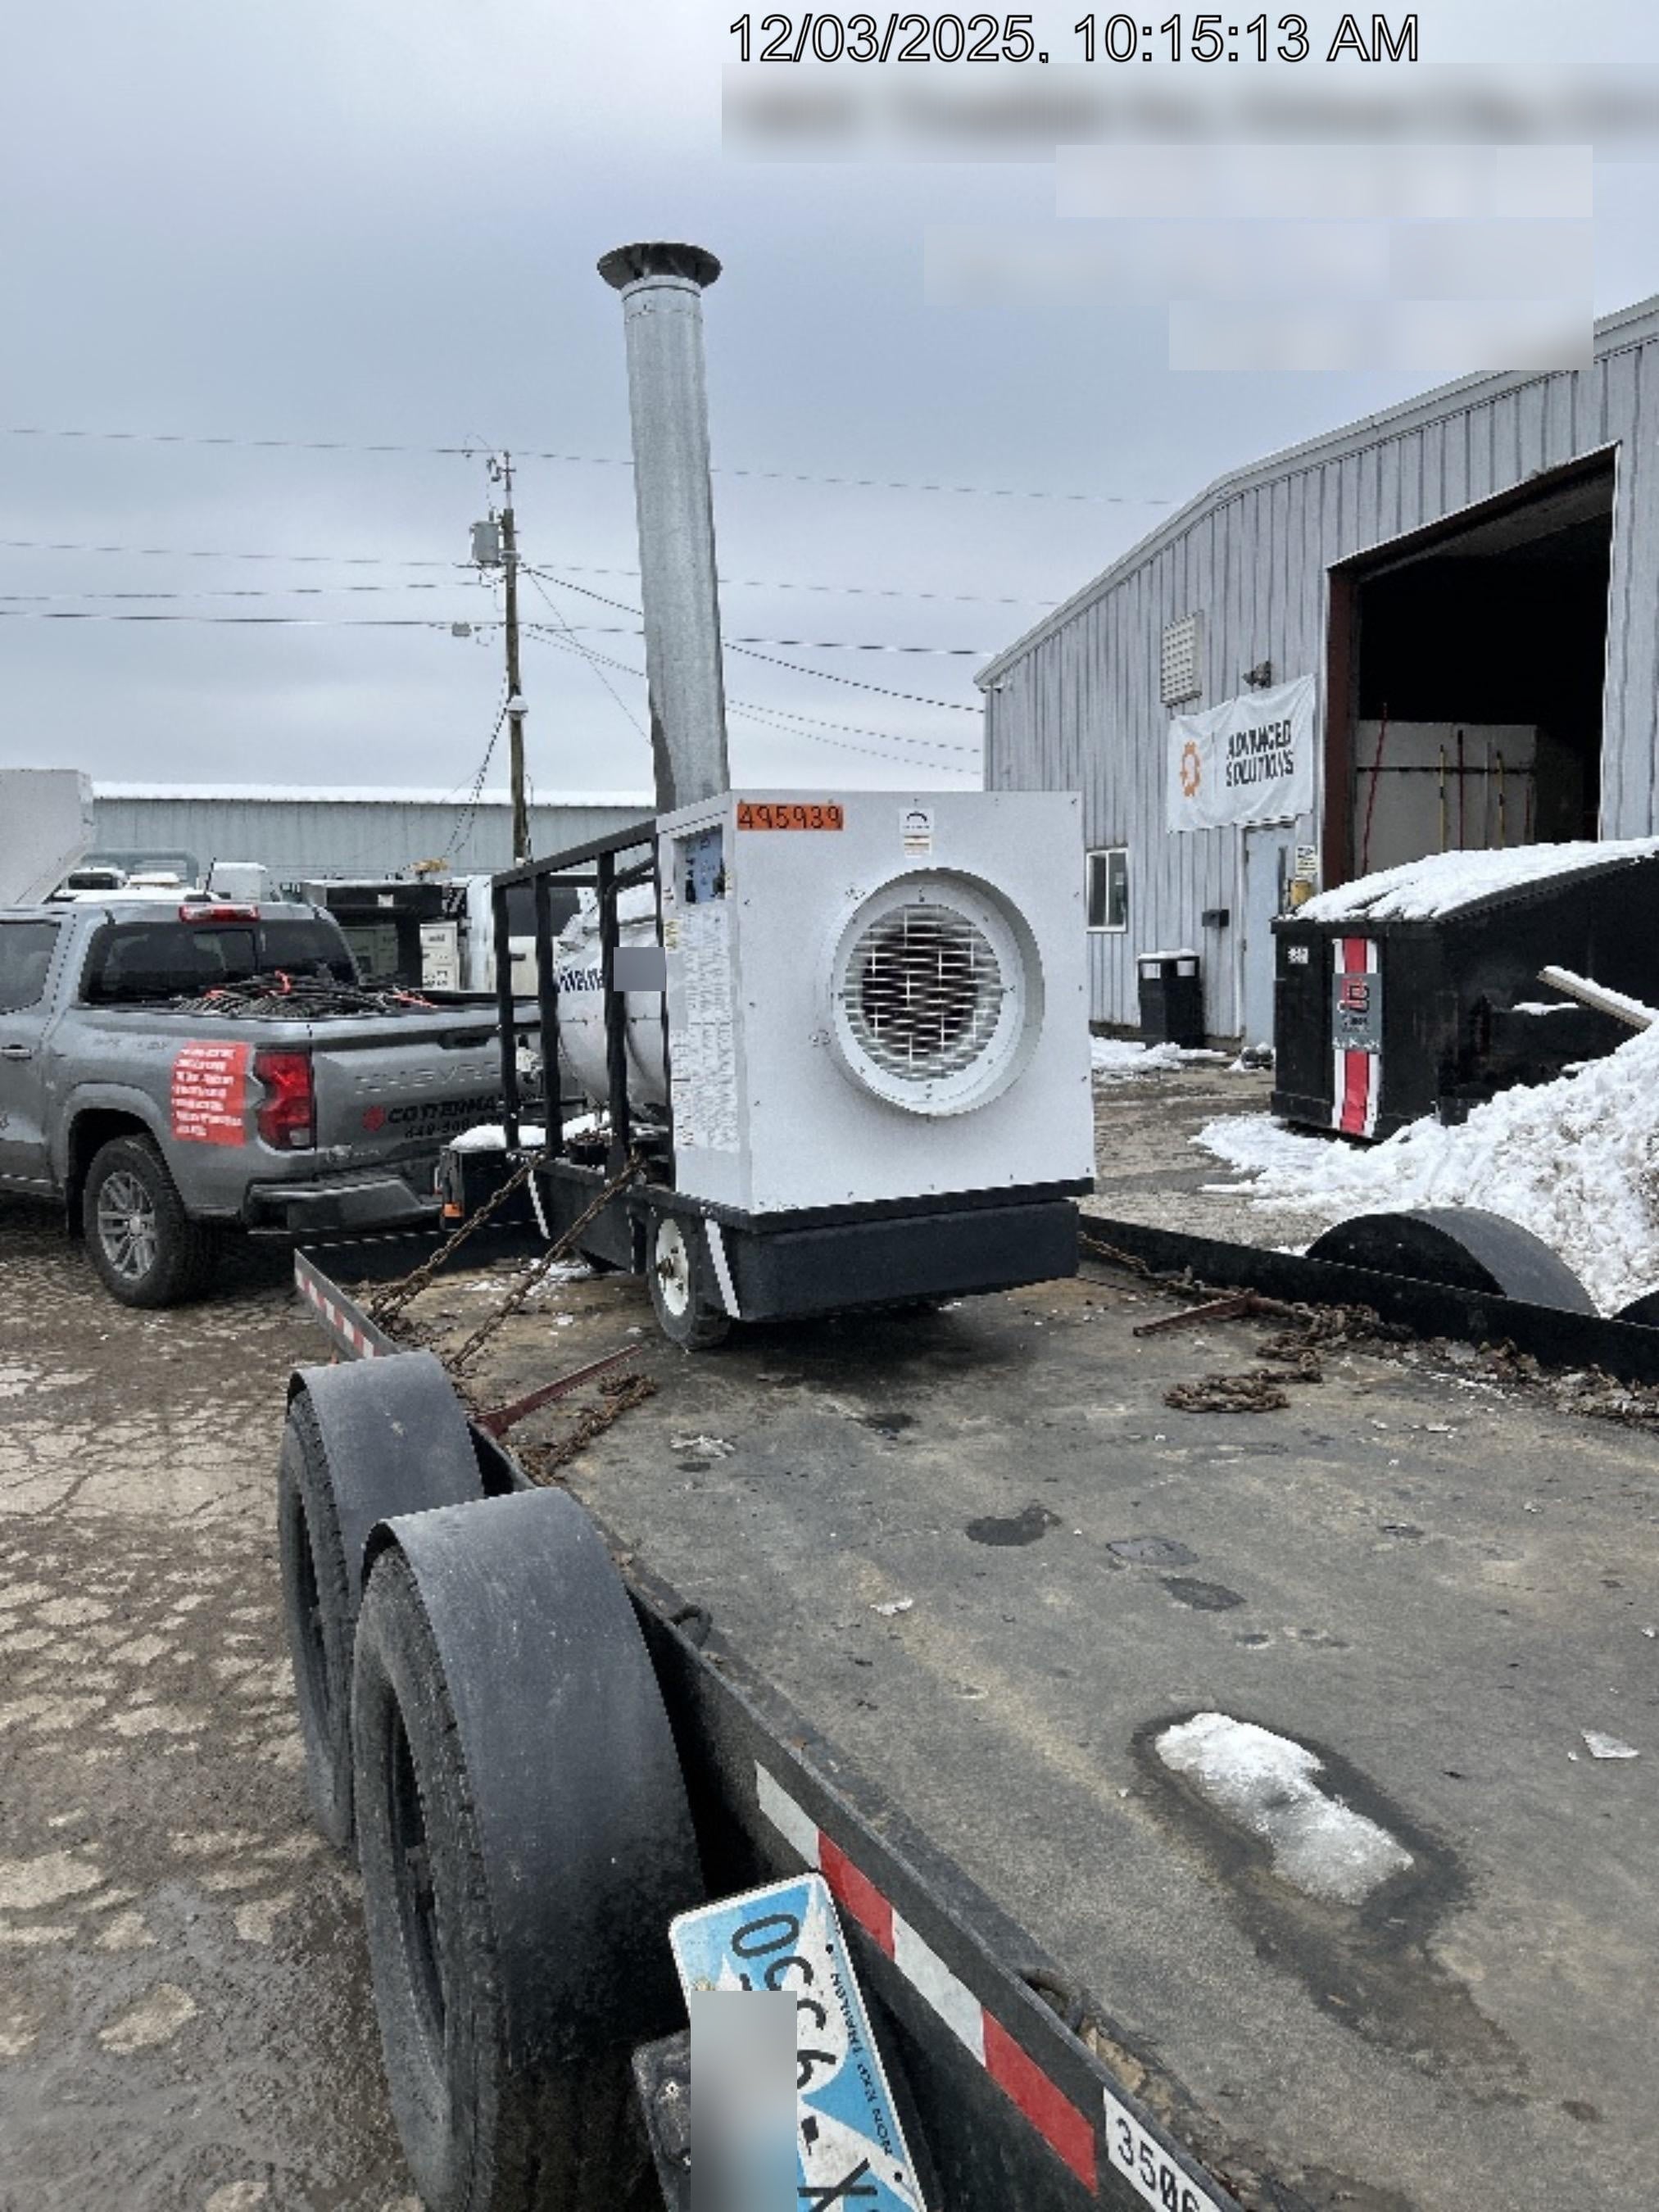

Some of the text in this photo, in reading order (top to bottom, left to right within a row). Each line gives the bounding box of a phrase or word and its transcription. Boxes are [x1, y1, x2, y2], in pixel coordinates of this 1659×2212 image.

[1229, 719, 1291, 758] ADVANCED
[1226, 749, 1294, 786] SOLUTIONS
[738, 805, 842, 830] 495939
[873, 2108, 893, 2156] NON
